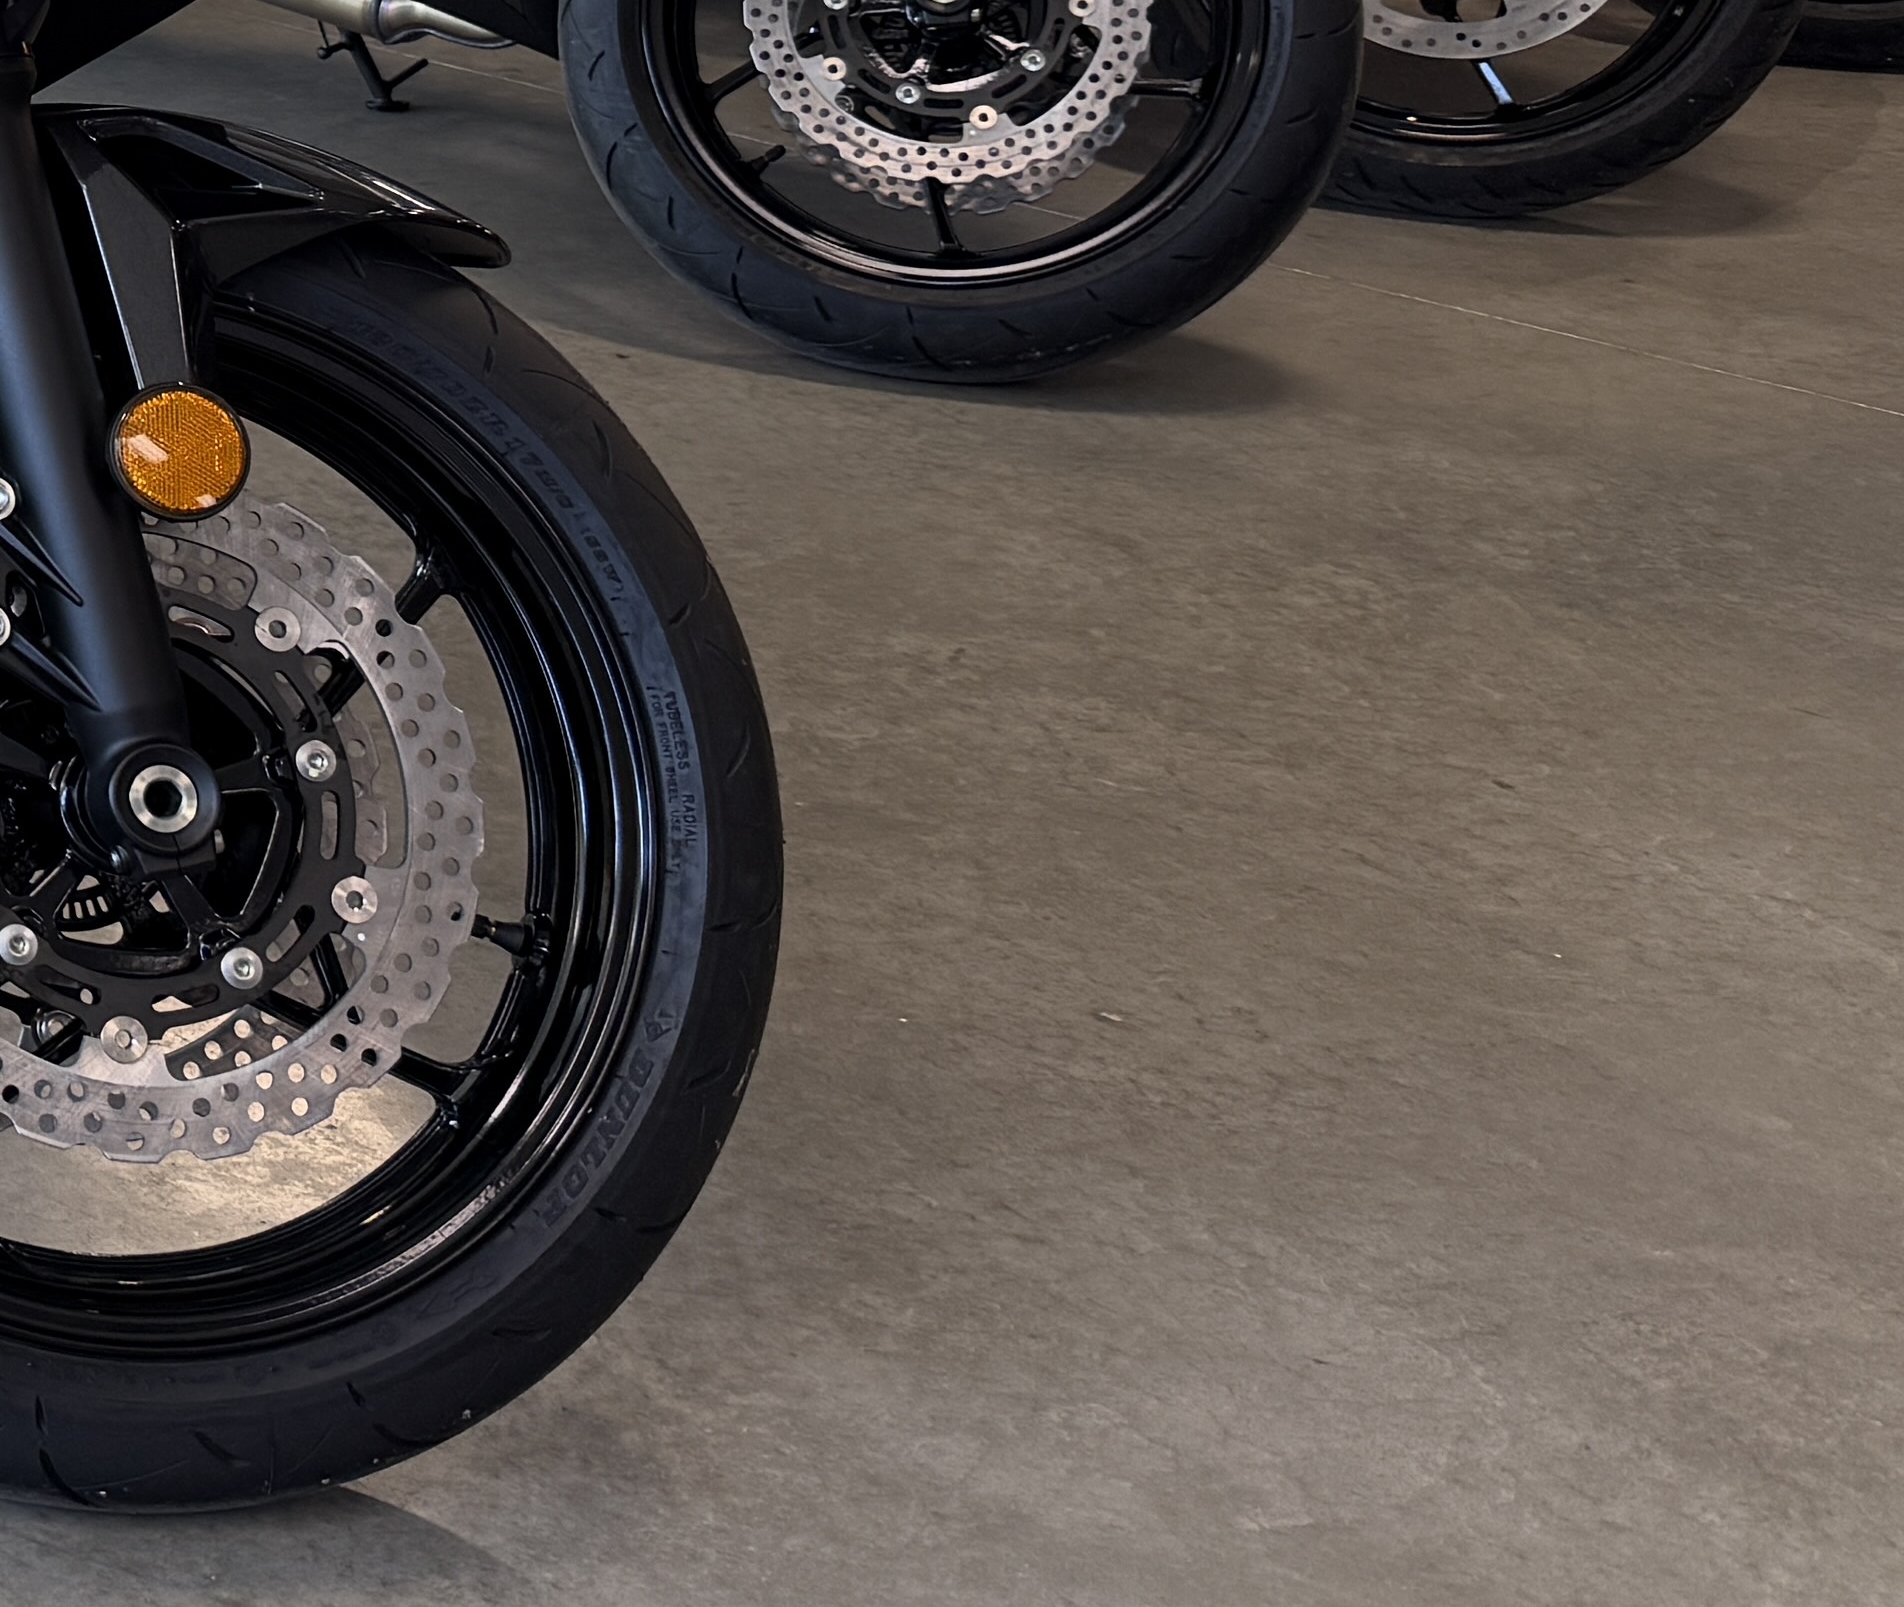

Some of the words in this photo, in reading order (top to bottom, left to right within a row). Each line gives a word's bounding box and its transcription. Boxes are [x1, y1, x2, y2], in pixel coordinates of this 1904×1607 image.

[664, 691, 691, 771] TUBELESS
[680, 794, 699, 844] RADIAL
[545, 1047, 655, 1228] DUNLOP
